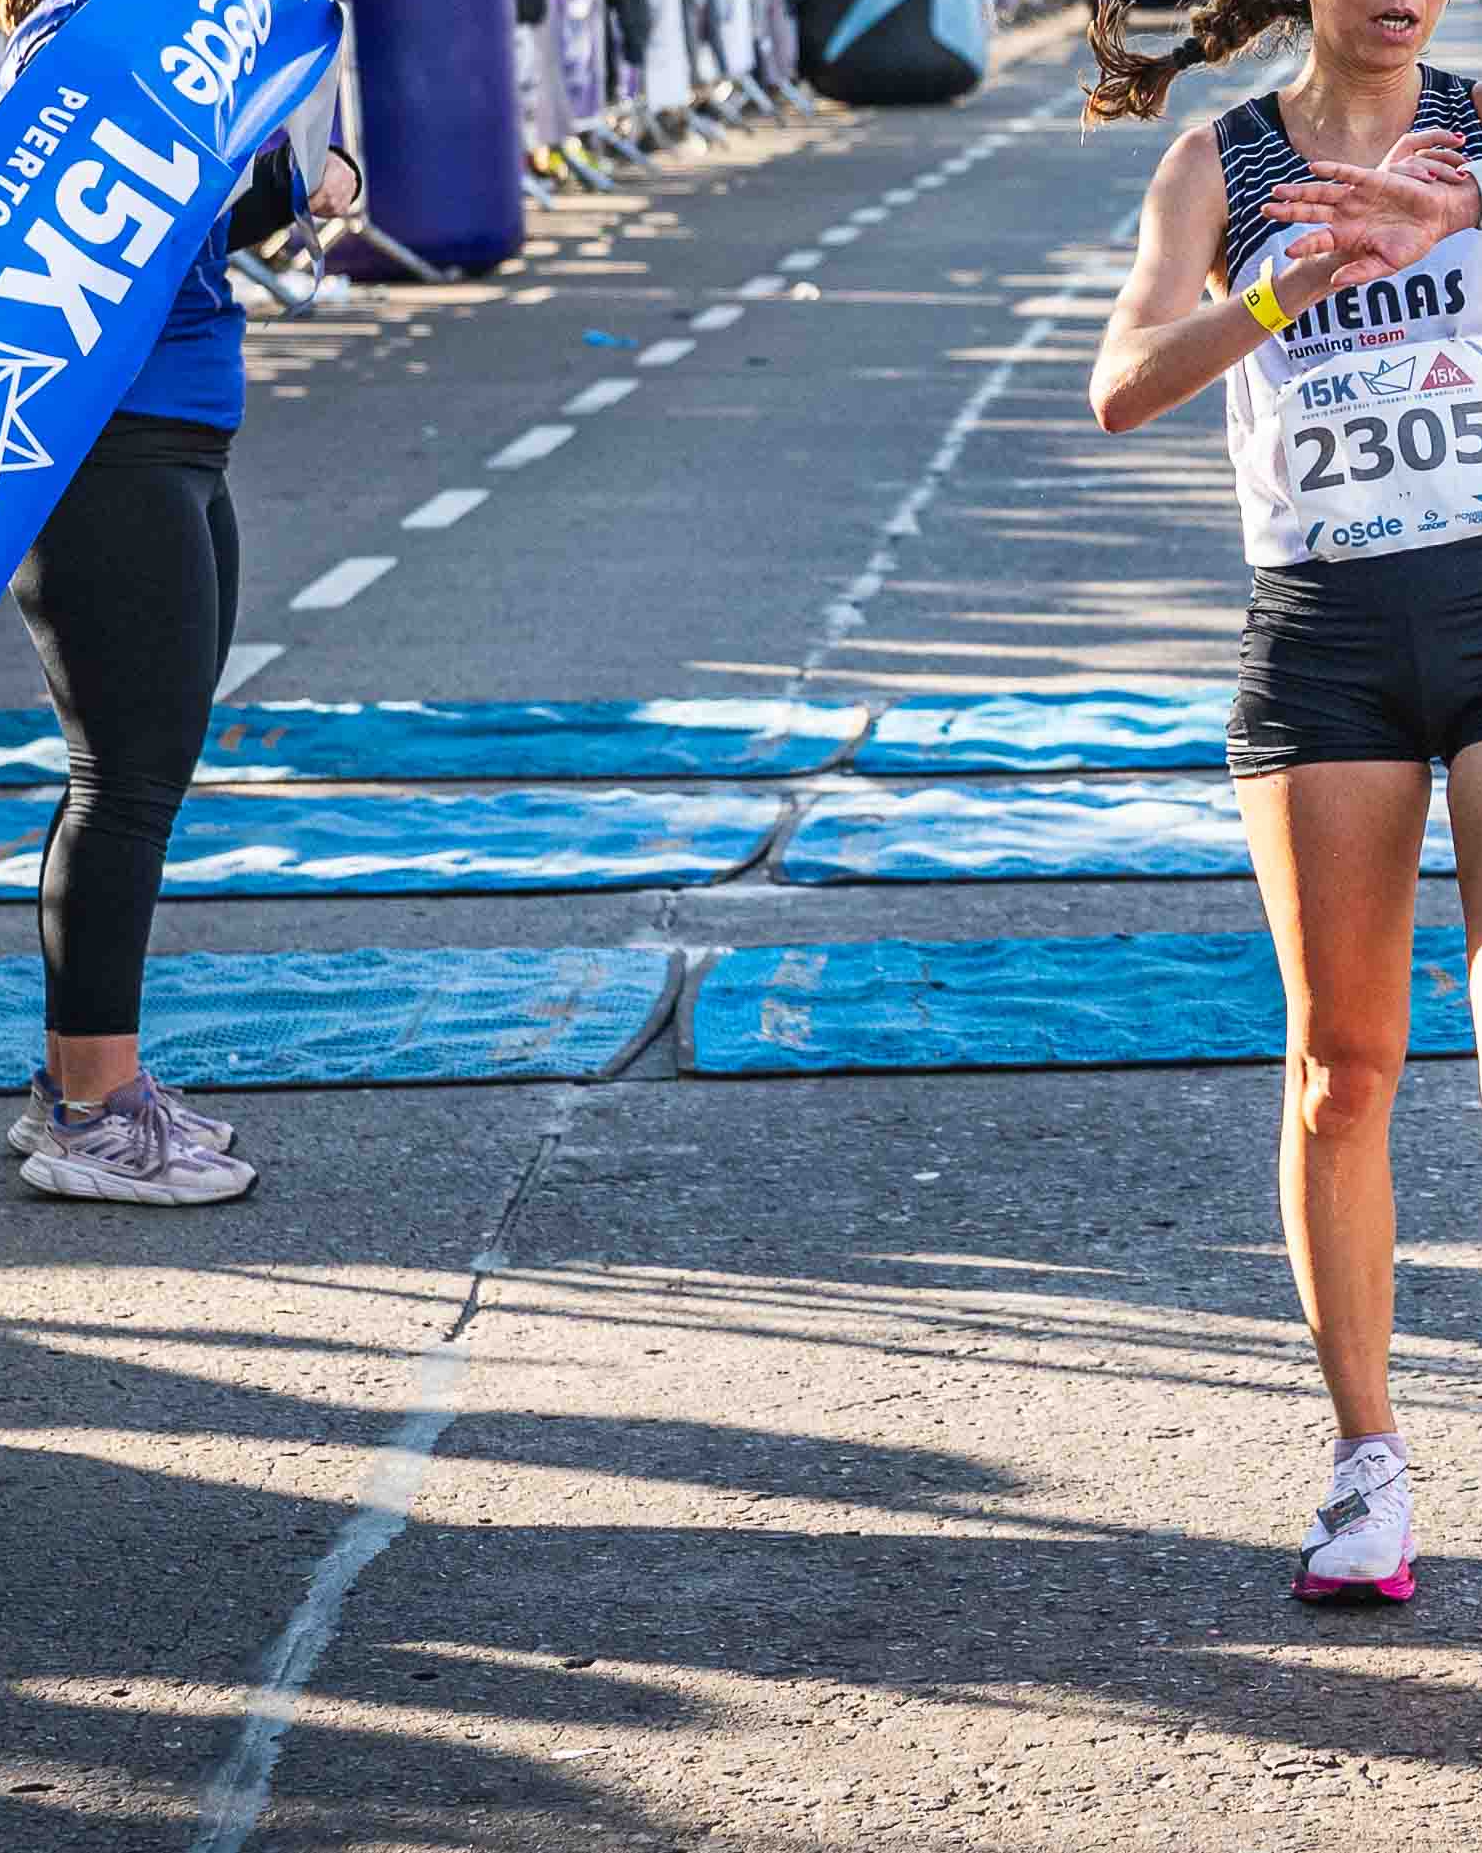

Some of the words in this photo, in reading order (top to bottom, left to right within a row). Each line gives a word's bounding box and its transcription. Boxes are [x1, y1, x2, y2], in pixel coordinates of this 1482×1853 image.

[1287, 334, 1353, 362] running
[1358, 327, 1406, 348] team
[1299, 373, 1359, 411] 15K
[1430, 366, 1462, 385] 15K
[1332, 515, 1404, 548] osde
